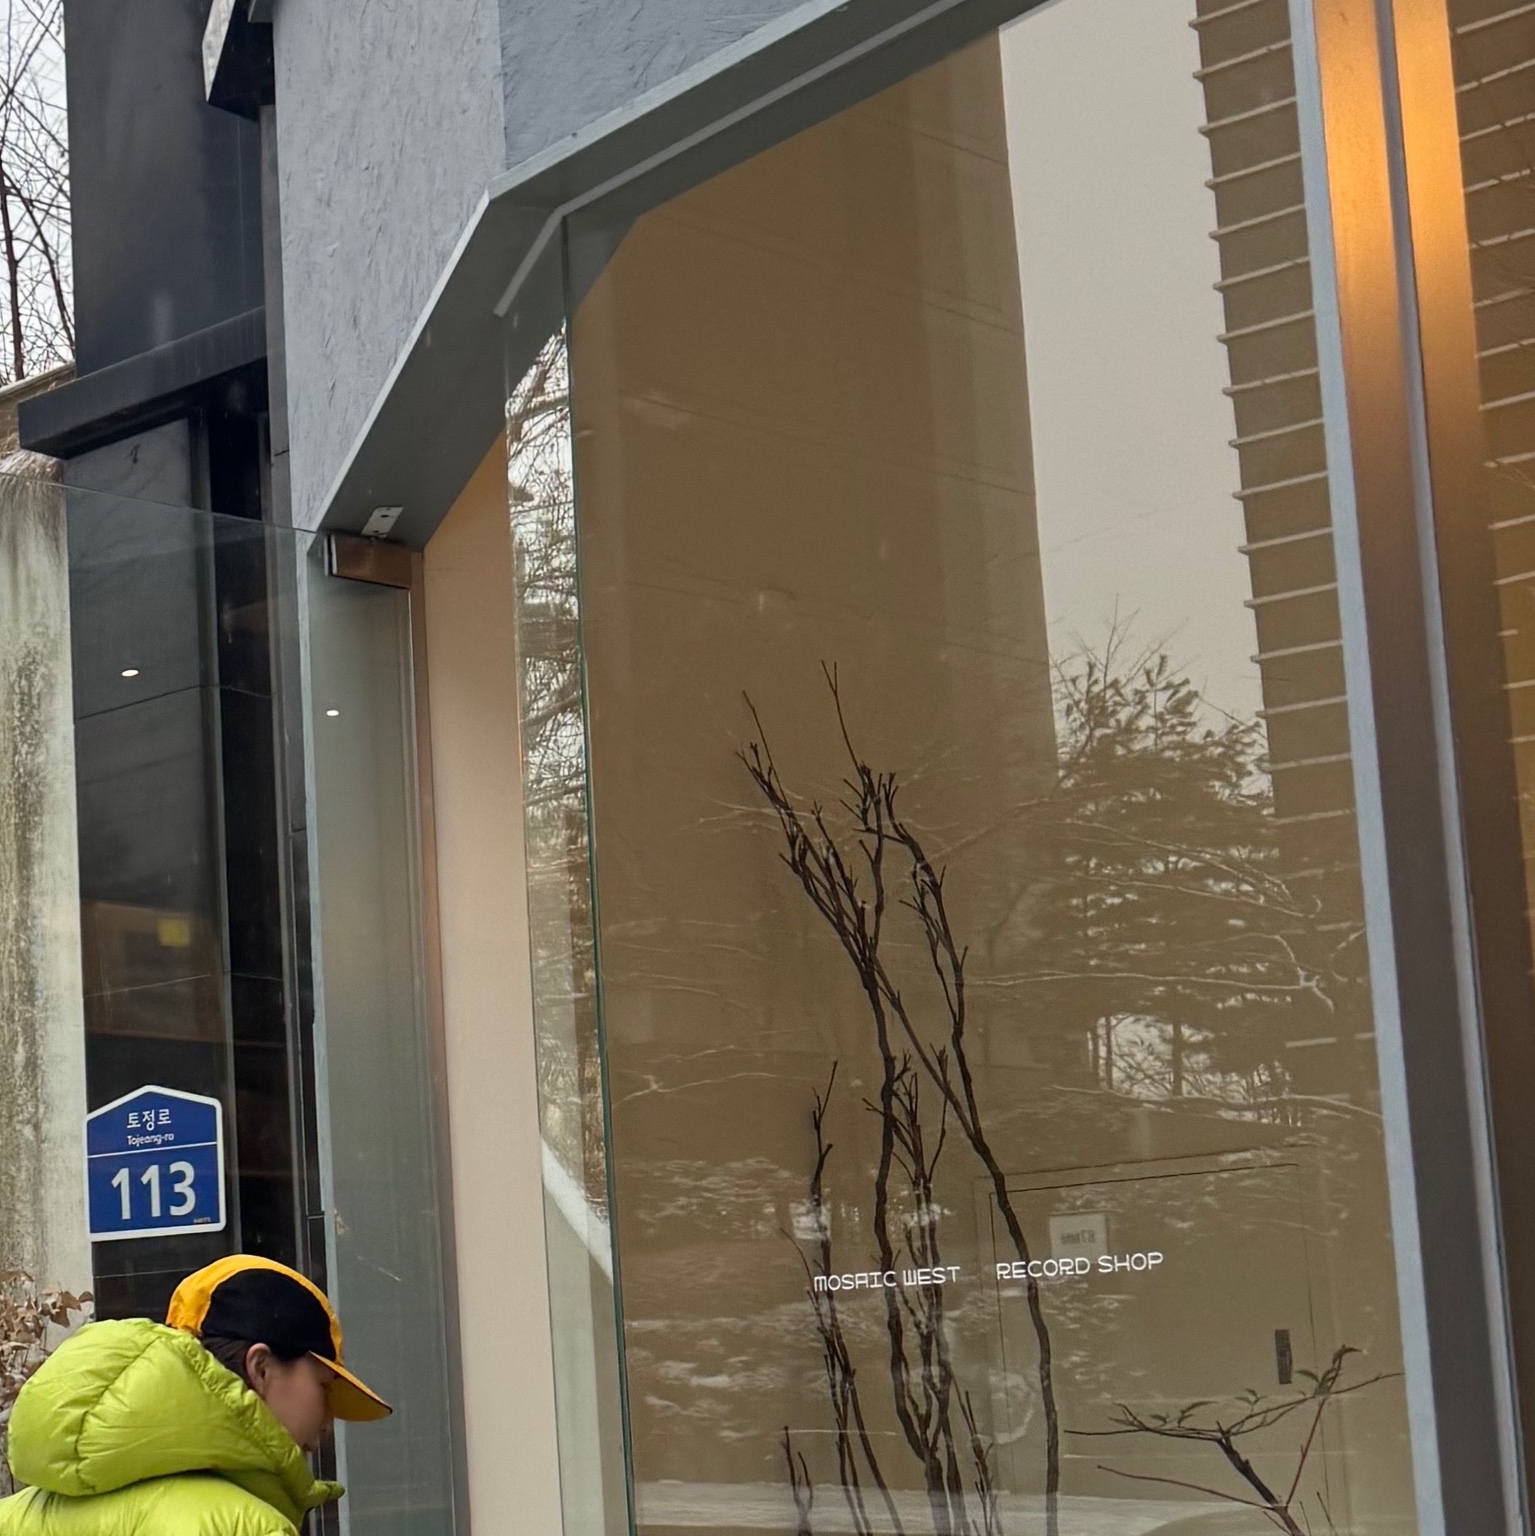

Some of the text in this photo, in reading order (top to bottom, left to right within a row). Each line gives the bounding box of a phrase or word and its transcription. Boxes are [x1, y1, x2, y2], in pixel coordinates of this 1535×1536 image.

[126, 1108, 172, 1131] 토정로
[111, 1161, 196, 1220] 113
[814, 1252, 1164, 1292] MOSAIC WEST RECORD SHOP
